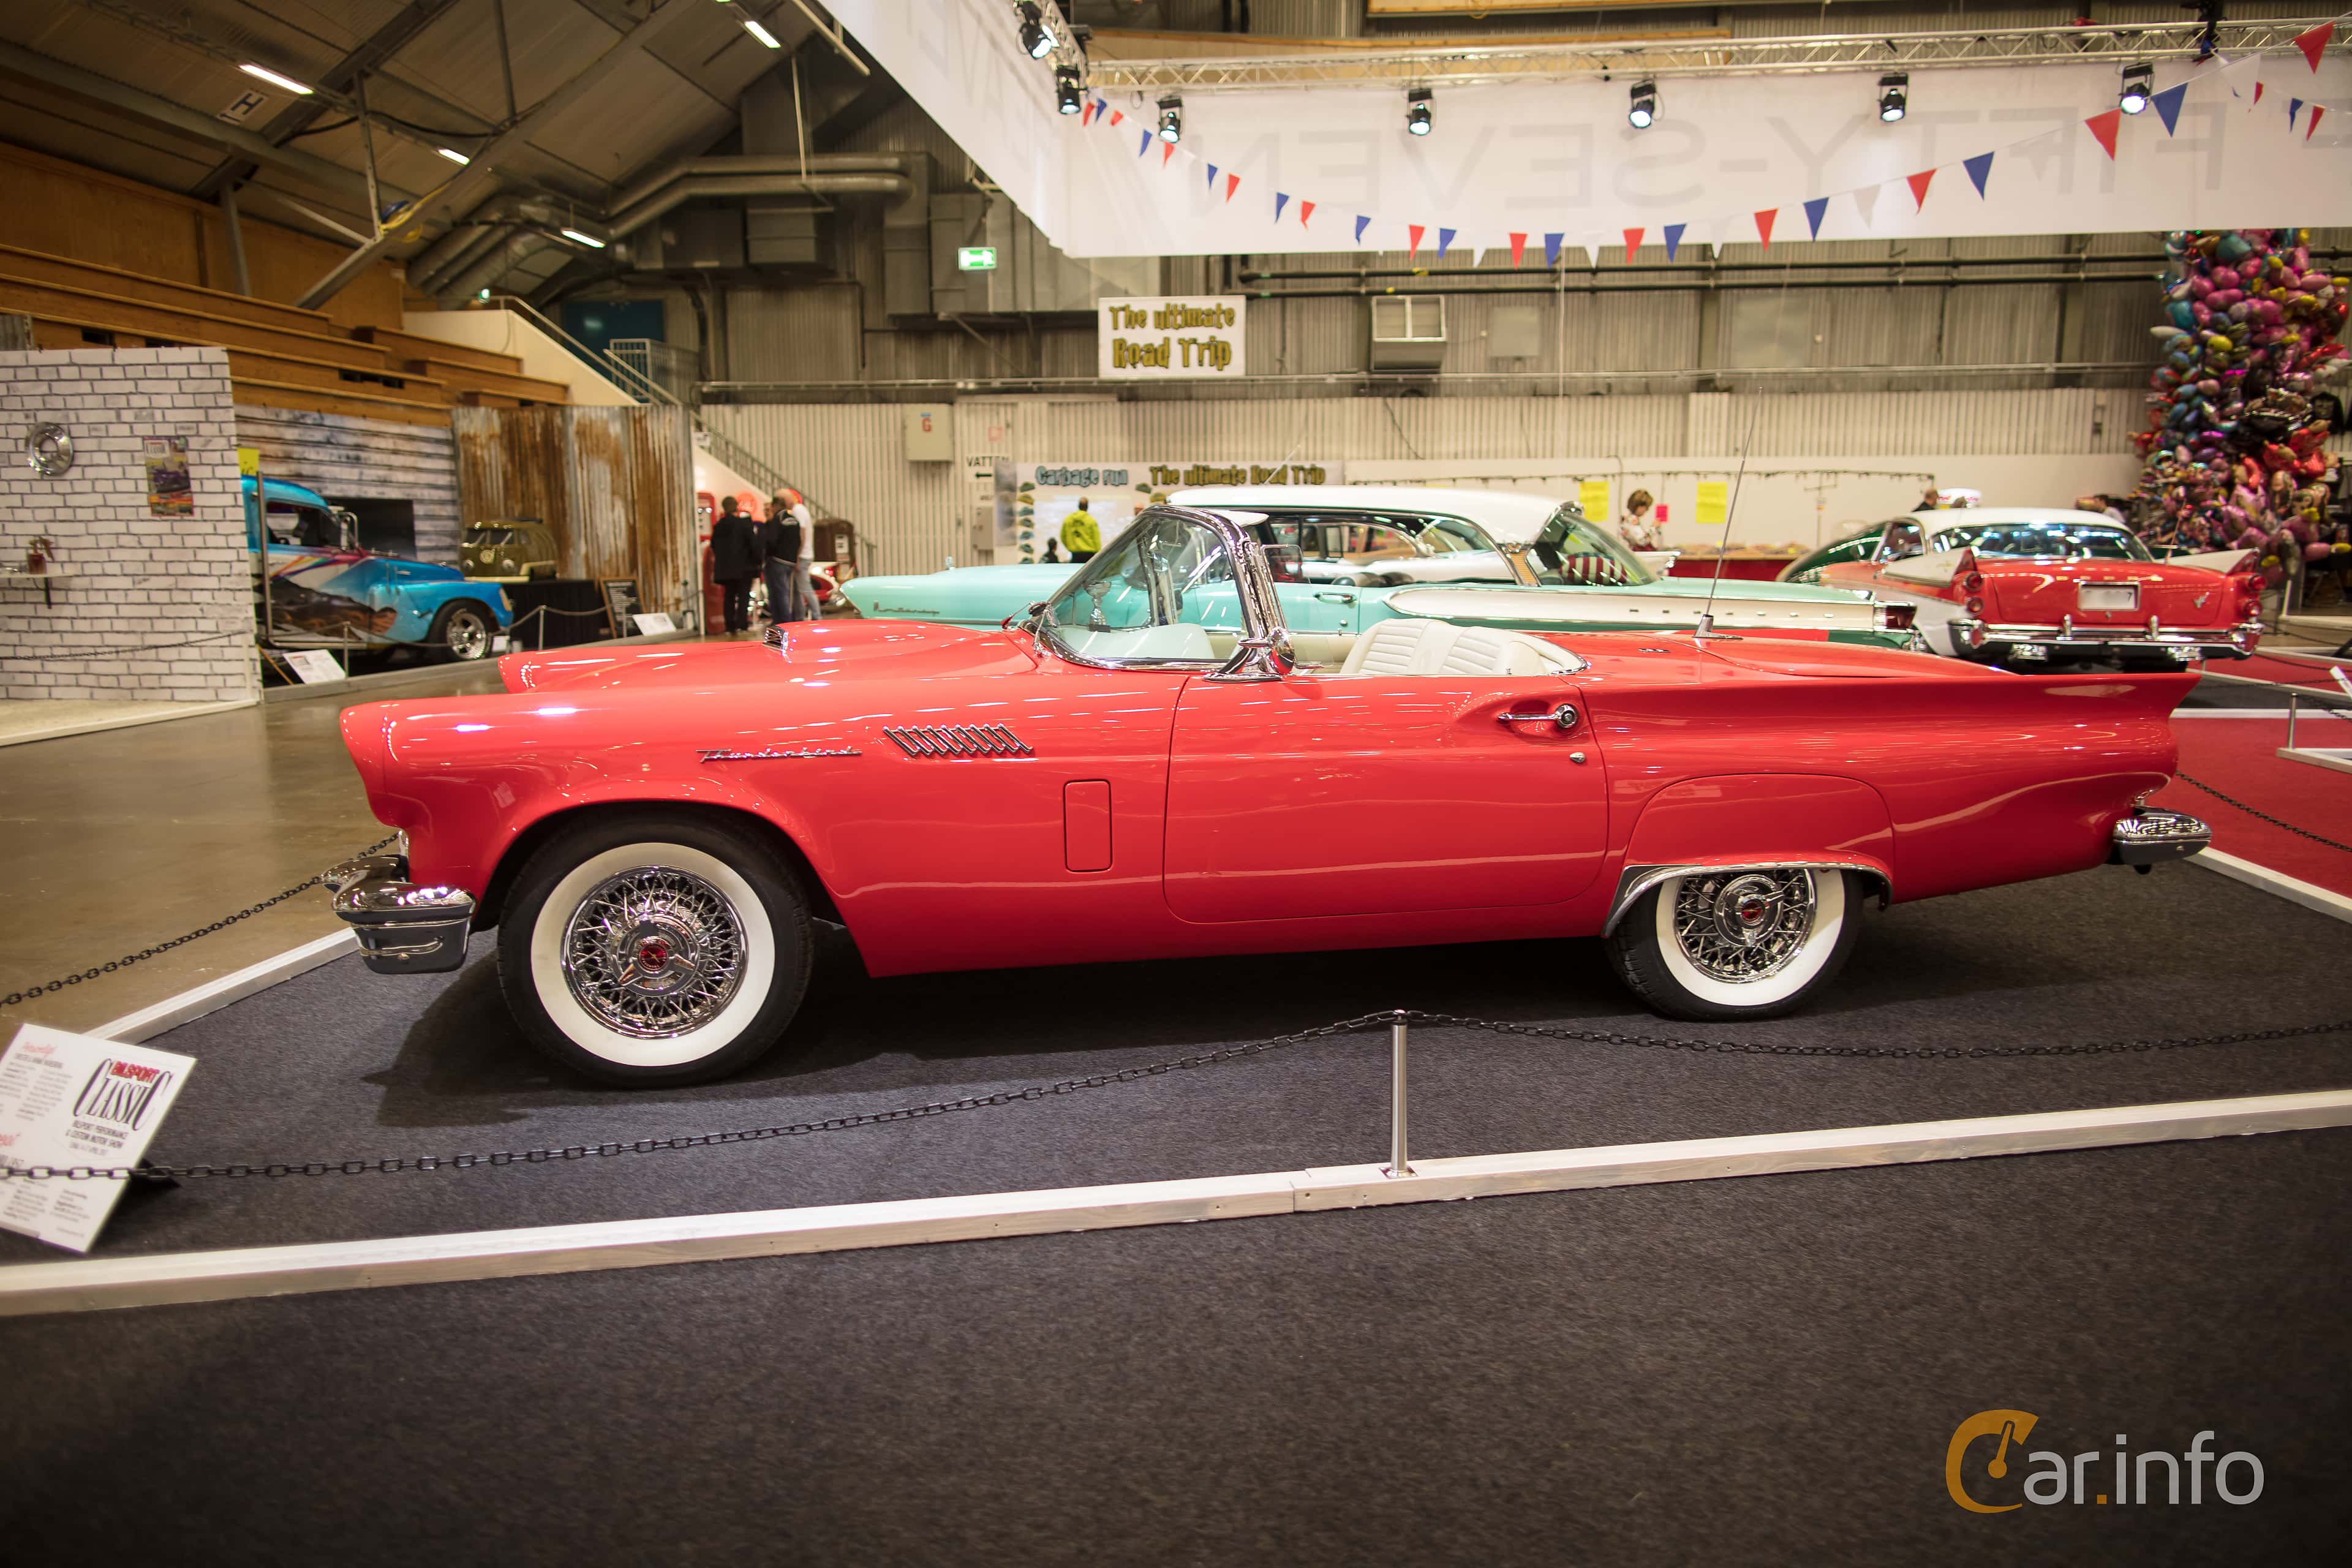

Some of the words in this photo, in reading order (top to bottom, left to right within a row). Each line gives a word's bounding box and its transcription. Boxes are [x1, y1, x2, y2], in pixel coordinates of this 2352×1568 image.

[1109, 304, 1147, 330] The
[1153, 303, 1235, 330] ultimate
[1113, 337, 1170, 368] Road
[1178, 336, 1231, 371] Trip
[1103, 469, 1128, 485] run
[1150, 464, 1180, 485] The
[1183, 464, 1246, 486] ultimate
[1250, 464, 1287, 485] Road
[1291, 464, 1325, 485] Trip
